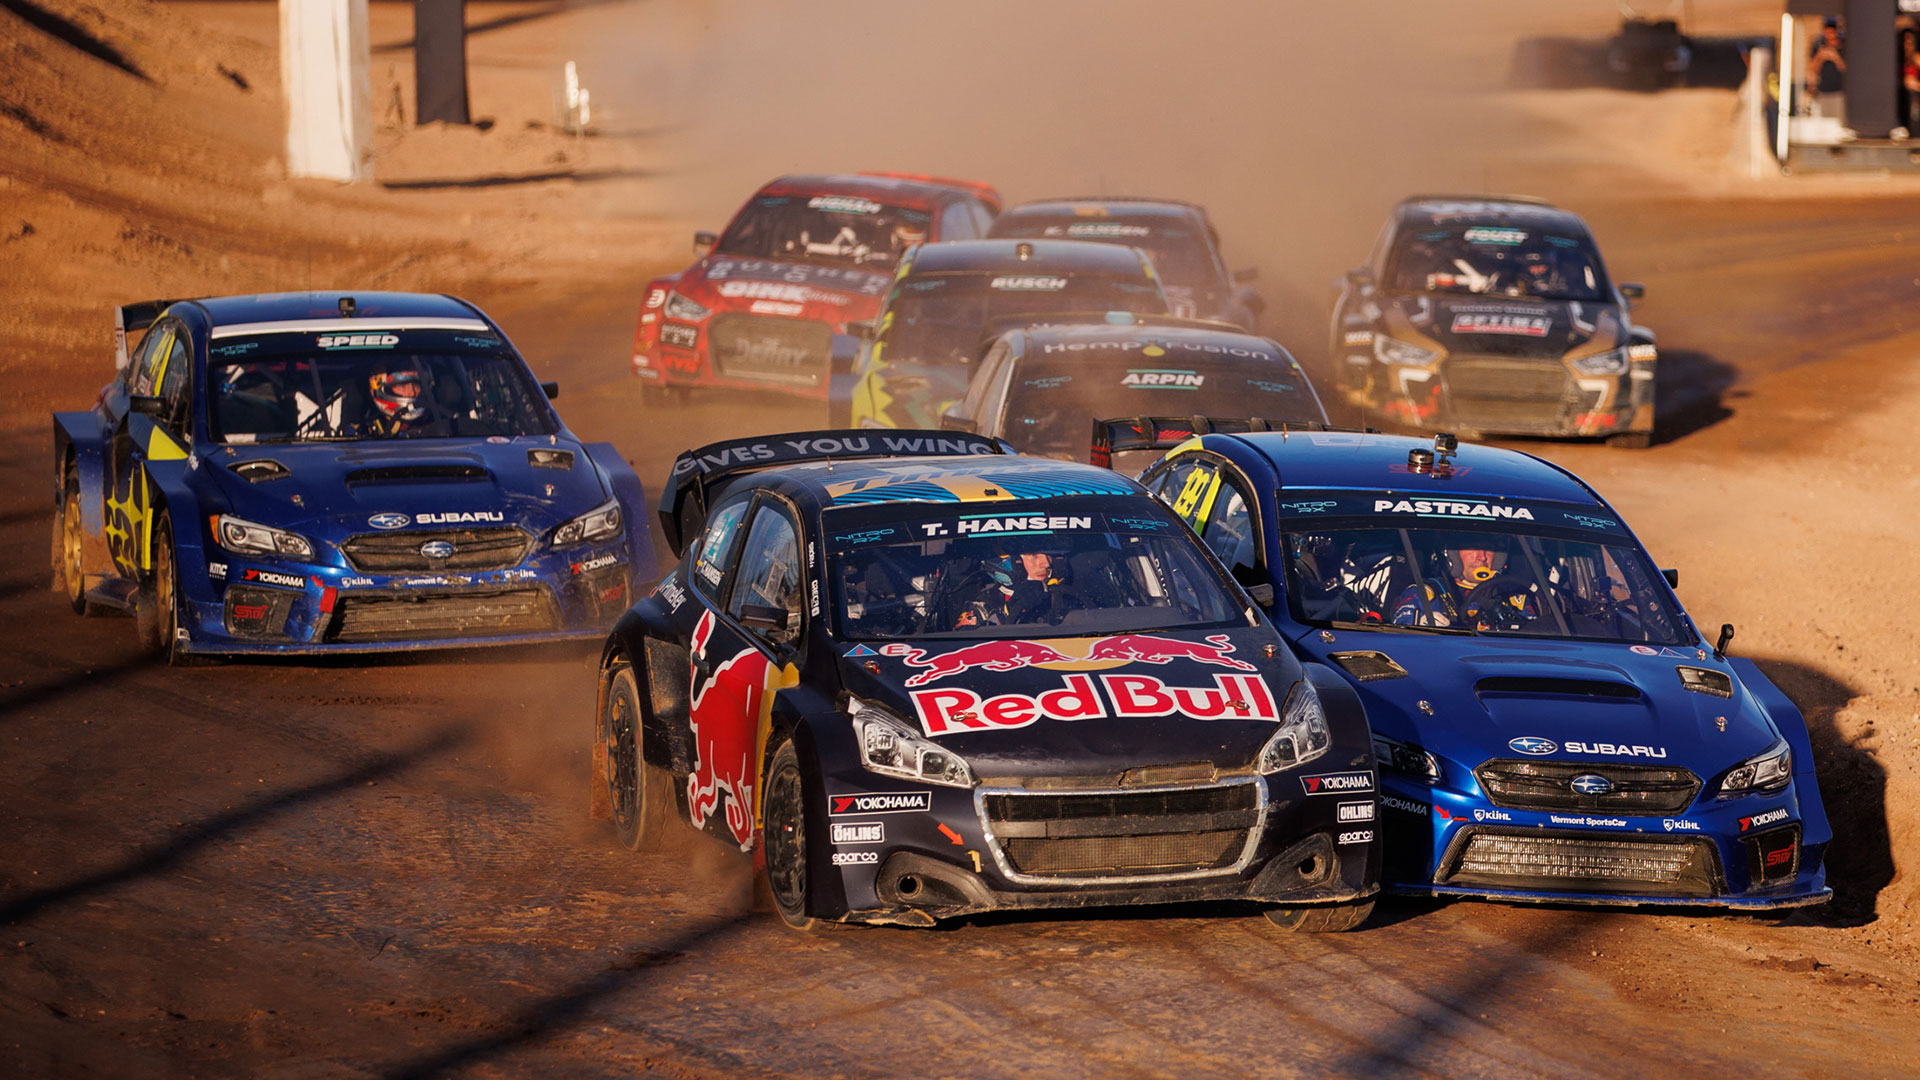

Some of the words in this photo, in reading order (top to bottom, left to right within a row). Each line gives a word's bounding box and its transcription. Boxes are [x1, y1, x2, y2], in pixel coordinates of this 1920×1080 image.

[991, 277, 1067, 289] BUSCH
[318, 335, 399, 347] SPEED
[1044, 341, 1142, 353] Hemp
[1166, 342, 1272, 361] Fusion
[1120, 373, 1204, 386] ARPIN
[673, 443, 776, 477] GIVES
[788, 437, 871, 455] YOU
[1281, 501, 1338, 510] NITRO
[1374, 500, 1535, 520] PASTRANA
[416, 511, 504, 524] SUBARU
[1112, 517, 1169, 527] NITRO
[1563, 513, 1617, 527] NITRO
[922, 522, 949, 537] T.
[957, 517, 1092, 533] HANSEN
[835, 528, 895, 542] NITRO
[209, 562, 228, 576] KMC
[259, 573, 305, 587] YOKOHAMA
[914, 675, 1105, 735] Red
[1104, 675, 1275, 719] Bull
[1565, 742, 1667, 758] SUBARU
[1321, 776, 1371, 789] YOKOHAMA
[856, 796, 924, 810] YOKOHAMA
[1380, 795, 1428, 816] OKOHAMA
[1485, 810, 1512, 821] KÜHL
[1550, 815, 1585, 825] Vermont
[1586, 818, 1628, 828] SportsCar
[1751, 808, 1789, 827] YOKOHAMA
[1674, 819, 1701, 831] KÜHL
[833, 824, 881, 842] ÖHLINS
[832, 852, 878, 865] sparco
